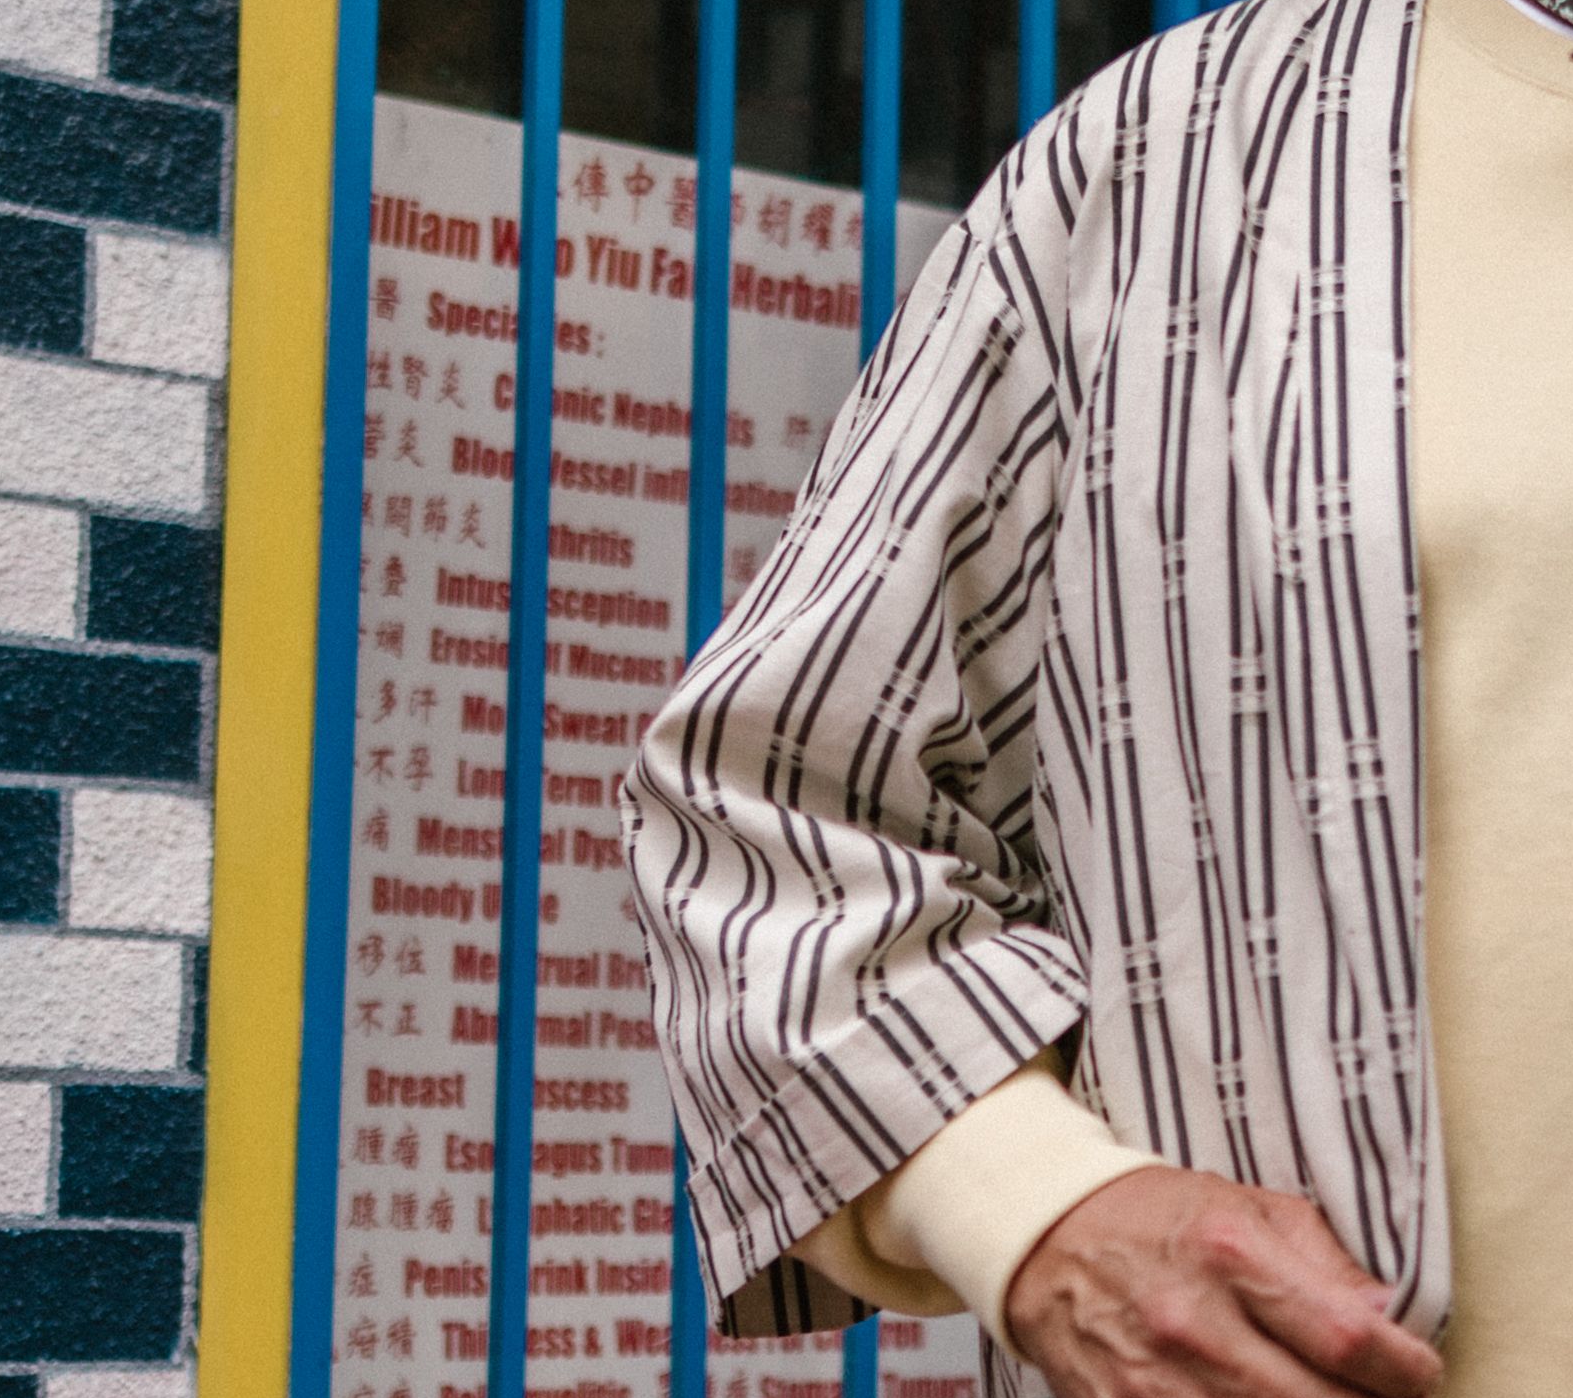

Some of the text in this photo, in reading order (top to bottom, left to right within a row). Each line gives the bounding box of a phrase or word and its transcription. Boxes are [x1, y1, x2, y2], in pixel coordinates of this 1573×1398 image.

[370, 193, 480, 264] illiam
[585, 234, 643, 293] Yiu
[730, 260, 861, 332] Herbali
[450, 433, 514, 484] Bloo
[567, 643, 667, 687] Mucous
[542, 702, 628, 748] Sweat
[354, 743, 434, 792] 不孕
[456, 757, 506, 800] Lon
[372, 875, 475, 924] Bloody
[366, 1066, 466, 1109] Breast
[404, 1257, 488, 1299] Penis
[583, 1324, 602, 1358] &
